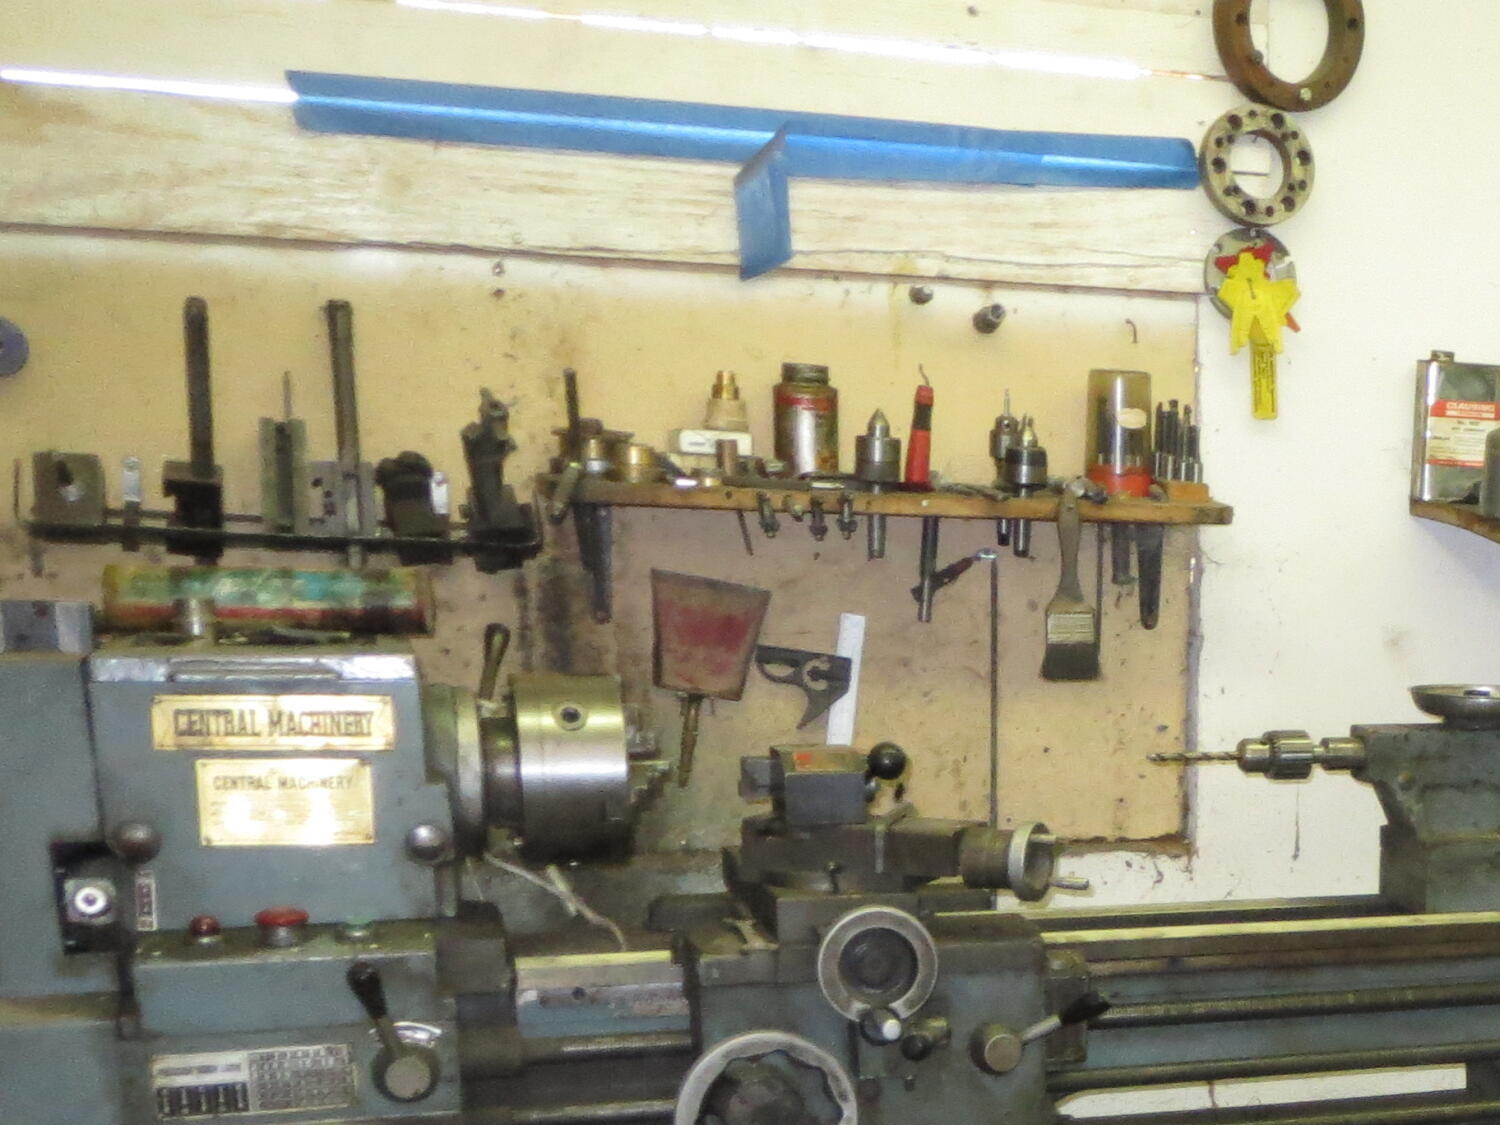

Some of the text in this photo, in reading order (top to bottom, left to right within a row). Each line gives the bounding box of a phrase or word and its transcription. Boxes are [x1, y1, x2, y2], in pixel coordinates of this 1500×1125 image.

[174, 708, 375, 737] CENTRAL MACHINERY
[213, 776, 272, 790] CENTRAL
